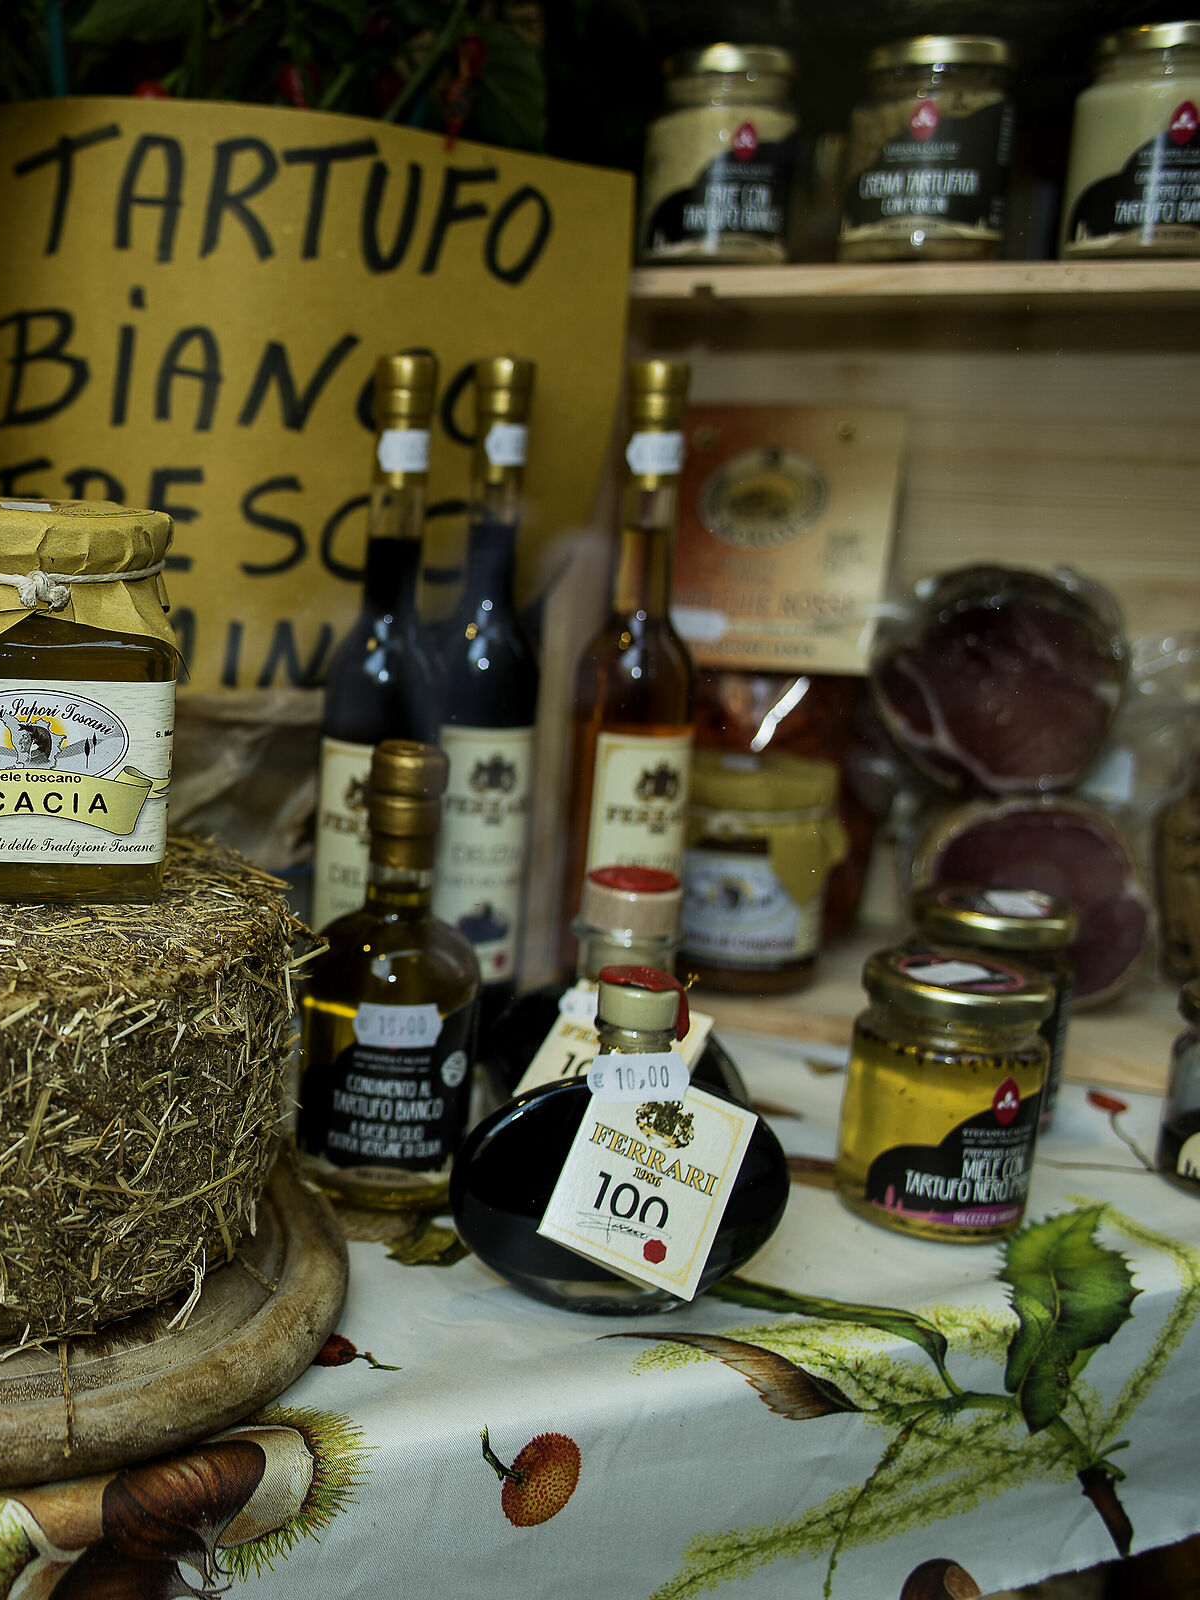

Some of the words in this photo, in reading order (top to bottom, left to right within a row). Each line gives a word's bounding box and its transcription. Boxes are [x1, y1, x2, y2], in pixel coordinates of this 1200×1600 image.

[12, 122, 554, 287] TARTUFO
[7, 698, 61, 723] Sapori
[61, 703, 119, 737] Toscani
[25, 772, 83, 785] toscano
[6, 836, 40, 852] delle
[39, 838, 109, 858] Tradizioni
[108, 838, 158, 854] Toscane
[592, 1074, 604, 1089] €
[615, 1065, 670, 1091] 10,00
[333, 1089, 393, 1121] TARTUFO
[394, 1098, 443, 1121] BIANCO
[589, 1122, 719, 1197] FERRARI
[961, 1158, 1001, 1180] MIELE
[632, 1166, 664, 1188] 1986
[904, 1168, 972, 1203] TARTUFO
[972, 1178, 1010, 1203] NERO
[593, 1170, 670, 1230] 100
